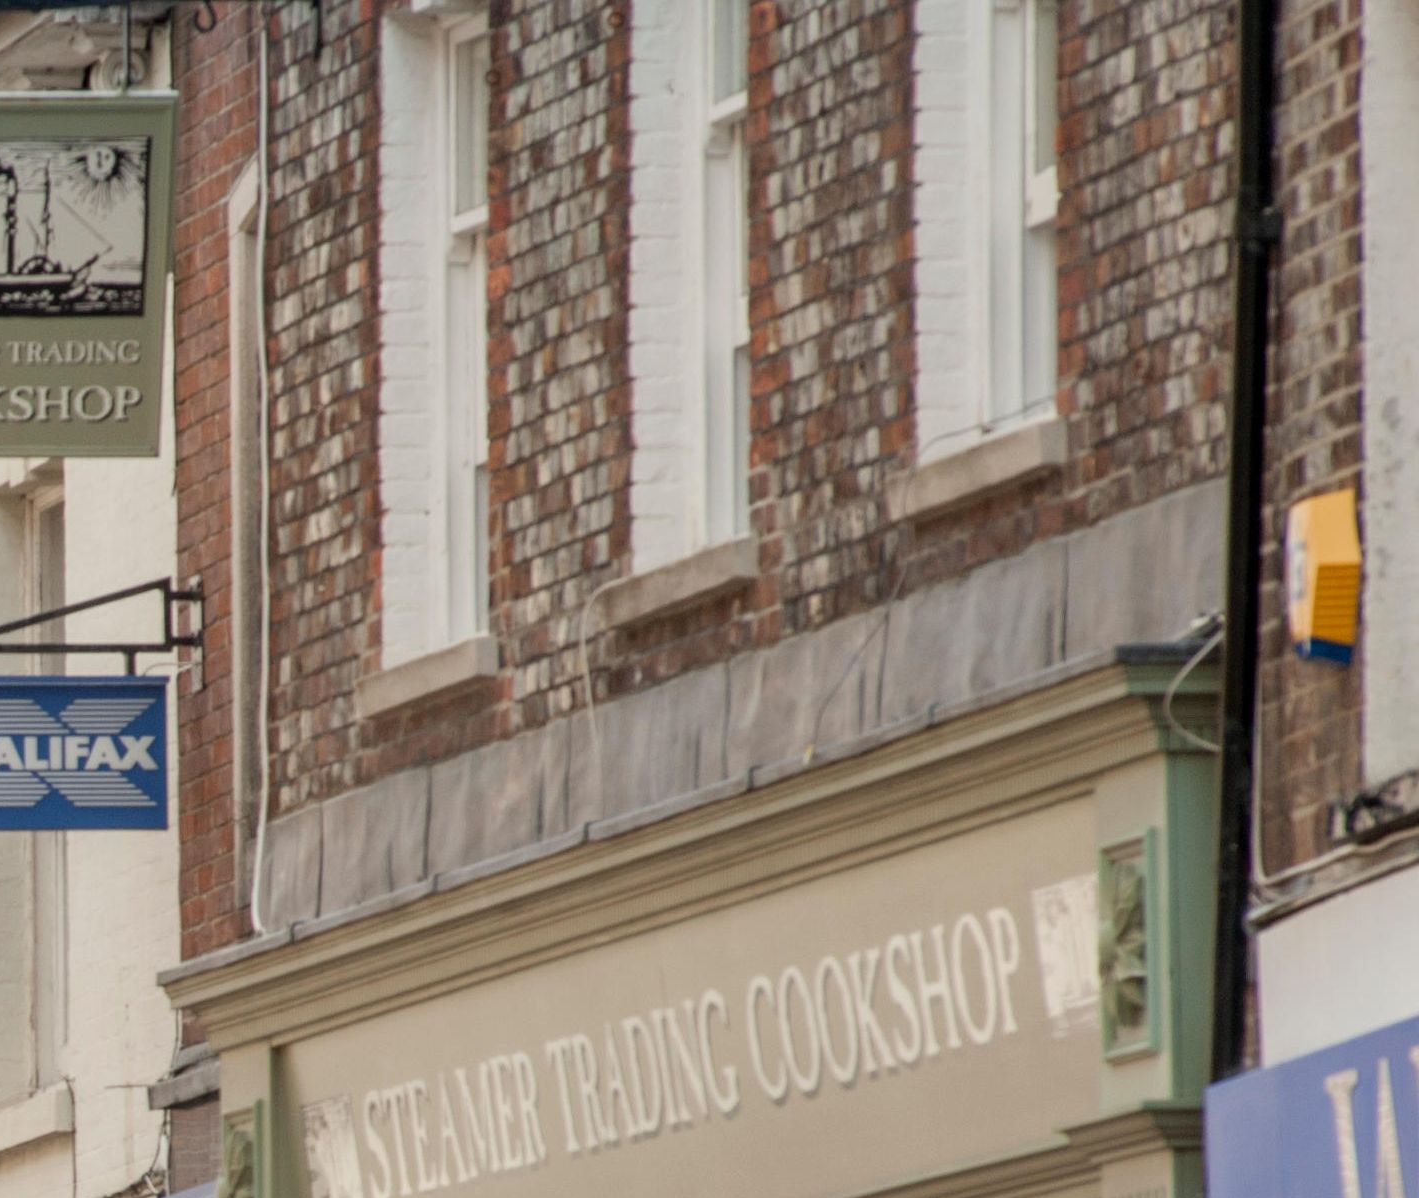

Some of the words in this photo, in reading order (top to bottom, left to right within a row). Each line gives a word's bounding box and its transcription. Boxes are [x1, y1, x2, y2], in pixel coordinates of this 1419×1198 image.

[11, 339, 141, 365] TRADING
[547, 989, 740, 1153] TRADING
[747, 908, 1021, 1101] COOKSHOP
